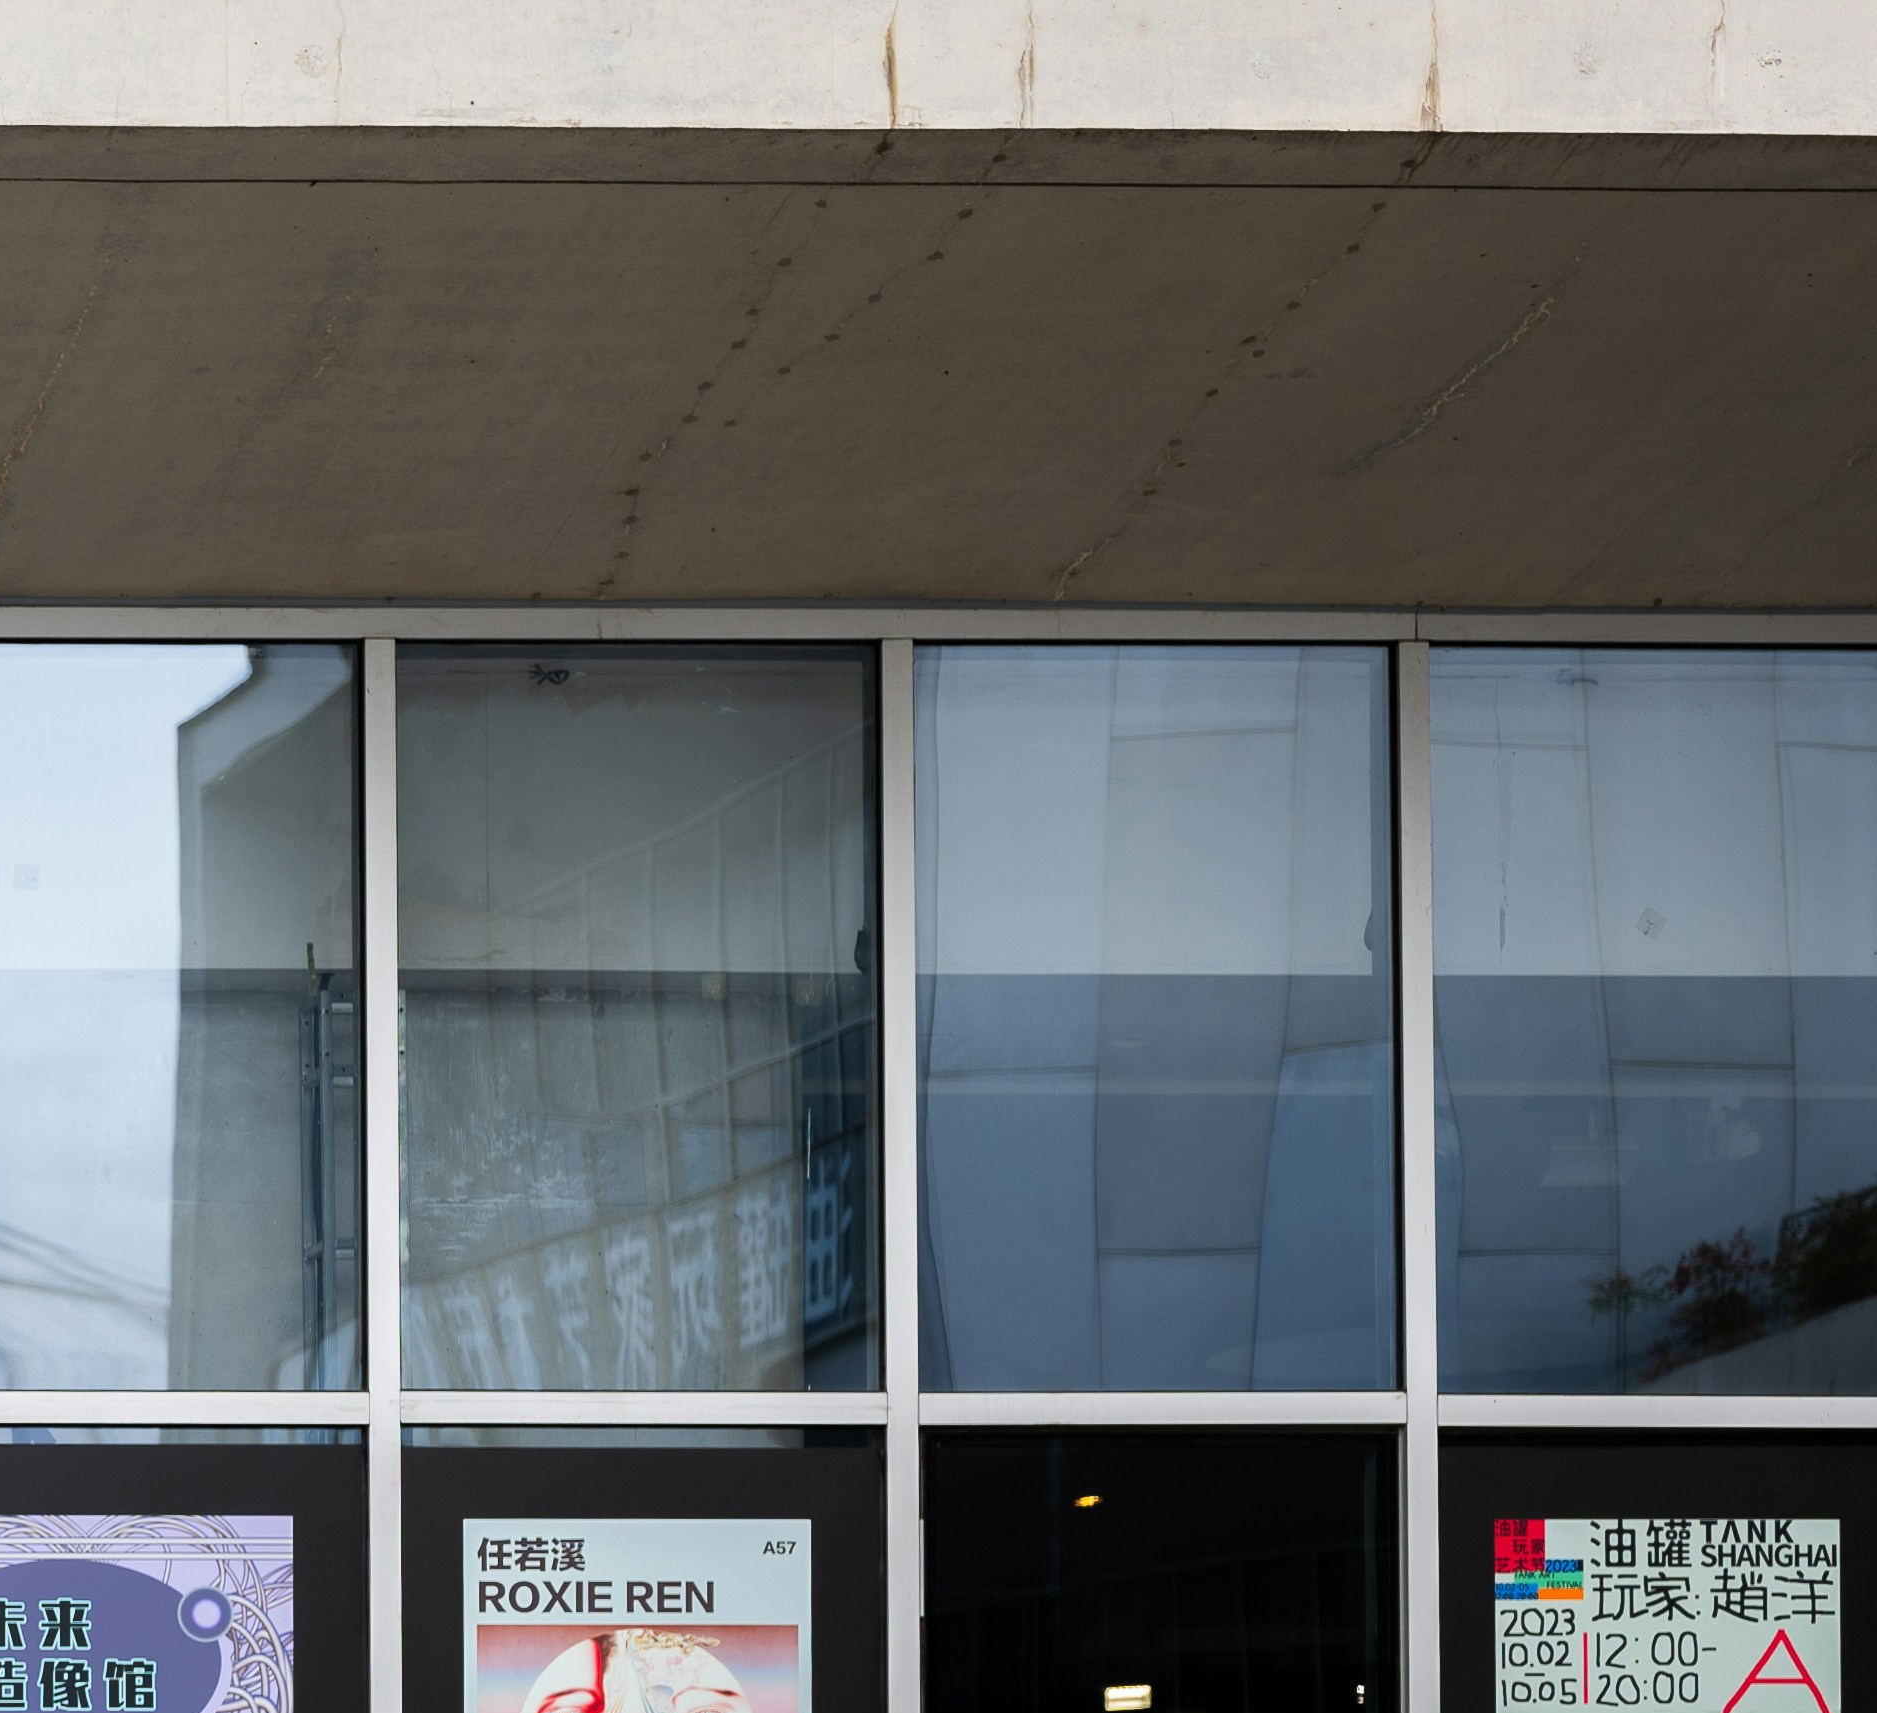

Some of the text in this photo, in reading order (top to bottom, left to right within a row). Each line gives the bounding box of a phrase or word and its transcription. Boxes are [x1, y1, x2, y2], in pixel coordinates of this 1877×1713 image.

[477, 1538, 796, 1572] 任若溪 A57
[1513, 1538, 1545, 1555] 玩家
[1590, 1518, 1793, 1567] 油罐 TANK
[1701, 1544, 1837, 1567] SHANGHAI
[1546, 1560, 1577, 1572] 2023
[478, 1580, 715, 1613] ROXIE REN
[1503, 1608, 1576, 1637] 2023
[1500, 1641, 1572, 1669] 10.02
[1500, 1671, 1699, 1707] 10.05 20:00
